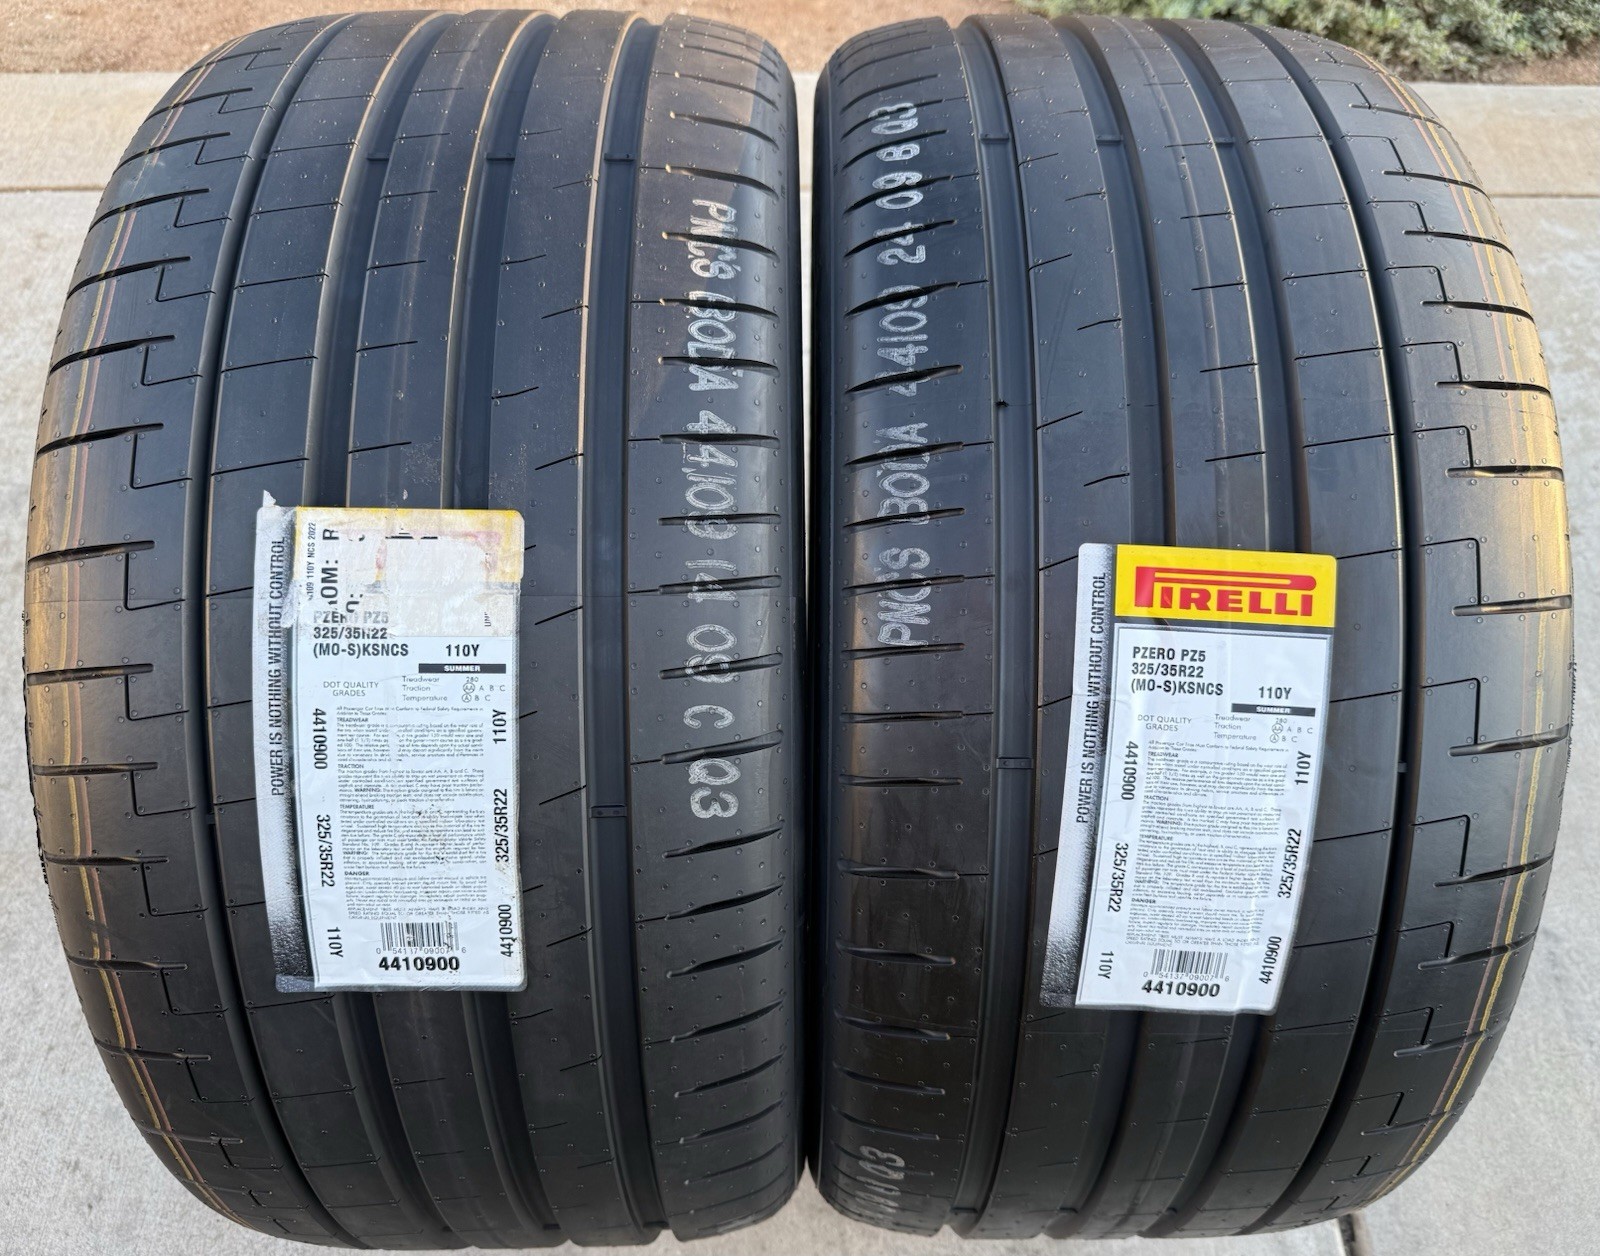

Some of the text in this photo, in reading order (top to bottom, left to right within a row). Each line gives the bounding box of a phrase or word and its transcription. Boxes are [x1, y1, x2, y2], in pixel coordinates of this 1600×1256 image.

[876, 143, 921, 161] B
[872, 171, 924, 209] 09
[873, 221, 926, 266] 24
[307, 522, 317, 540] 2022
[307, 542, 317, 558] NCS
[1135, 566, 1316, 617] PIRELLI
[313, 643, 409, 658] (MO-S)KSNCS
[445, 644, 480, 657] 110Y
[686, 623, 737, 683] 09
[1132, 647, 1206, 662] PZERO PZ5
[268, 537, 286, 796] POWER IS NOTHING WITHOUT CONTROL
[1132, 663, 1204, 678] 325/35R22
[343, 681, 378, 689] QUALITY
[1076, 572, 1106, 824] POWER IS NOTHING WITHOUT CONTROL
[1131, 678, 1224, 696] (MO-S)KSNCS
[1258, 686, 1292, 700] 110Y
[492, 709, 507, 745] 110Y
[684, 704, 735, 729] C
[1146, 723, 1178, 732] GRADES
[1157, 716, 1192, 724] QUALITY
[1215, 714, 1251, 722] Treadwear
[312, 708, 328, 770] 4410900
[1214, 732, 1256, 741] Temperature
[1121, 741, 1139, 800] 4410900
[1294, 751, 1311, 785] 110Y
[688, 758, 741, 819] Q3
[493, 789, 509, 863] 325/35R22
[317, 814, 335, 887] 325/35R22
[1278, 828, 1302, 899] 325/35R22
[1107, 842, 1129, 913] 325/35R22
[327, 927, 344, 958] 110Y
[498, 904, 513, 958] 4410900
[379, 956, 460, 971] 4410900
[1098, 951, 1114, 980] 110Y
[1259, 936, 1282, 985] 4410900
[1141, 979, 1221, 997] 4410900
